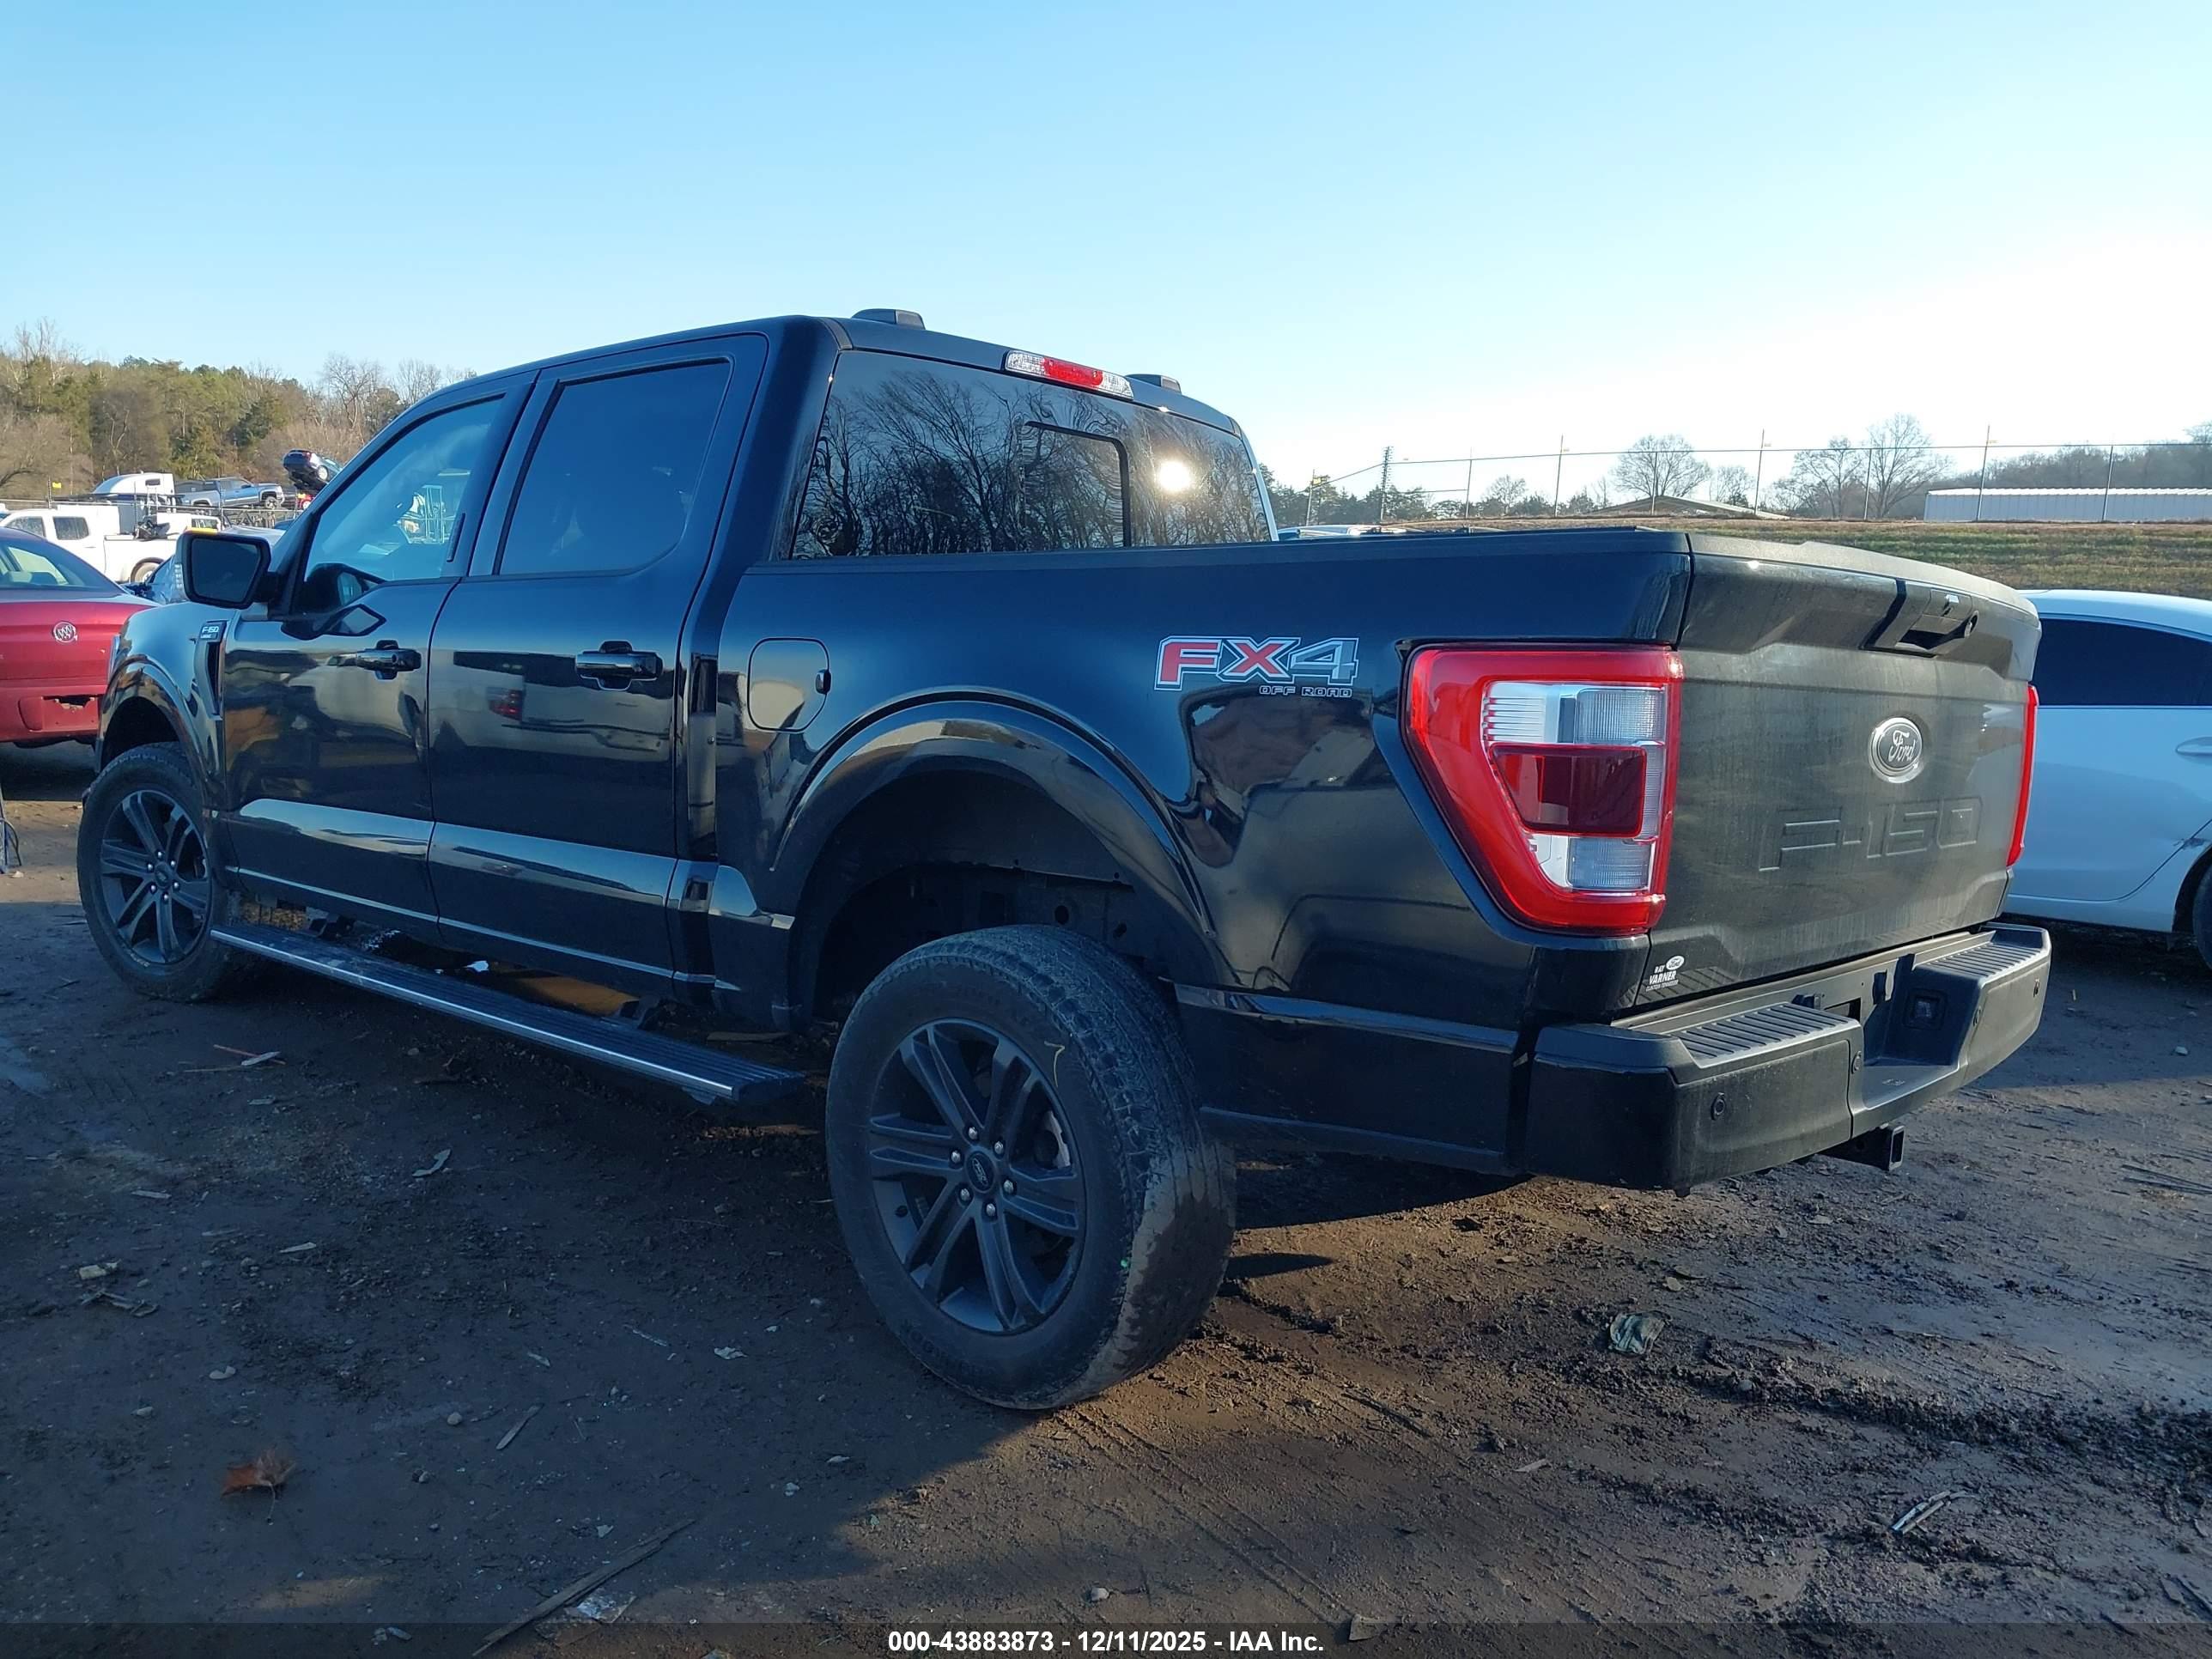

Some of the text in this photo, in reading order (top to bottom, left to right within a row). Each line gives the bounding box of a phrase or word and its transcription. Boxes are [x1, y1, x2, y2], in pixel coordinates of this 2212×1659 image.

[1154, 635, 1359, 690] FX4
[1259, 685, 1352, 698] OFF ROAD
[1887, 729, 1917, 763] Ford
[1759, 796, 1982, 872] F-150
[1650, 971, 1676, 985] VARNER
